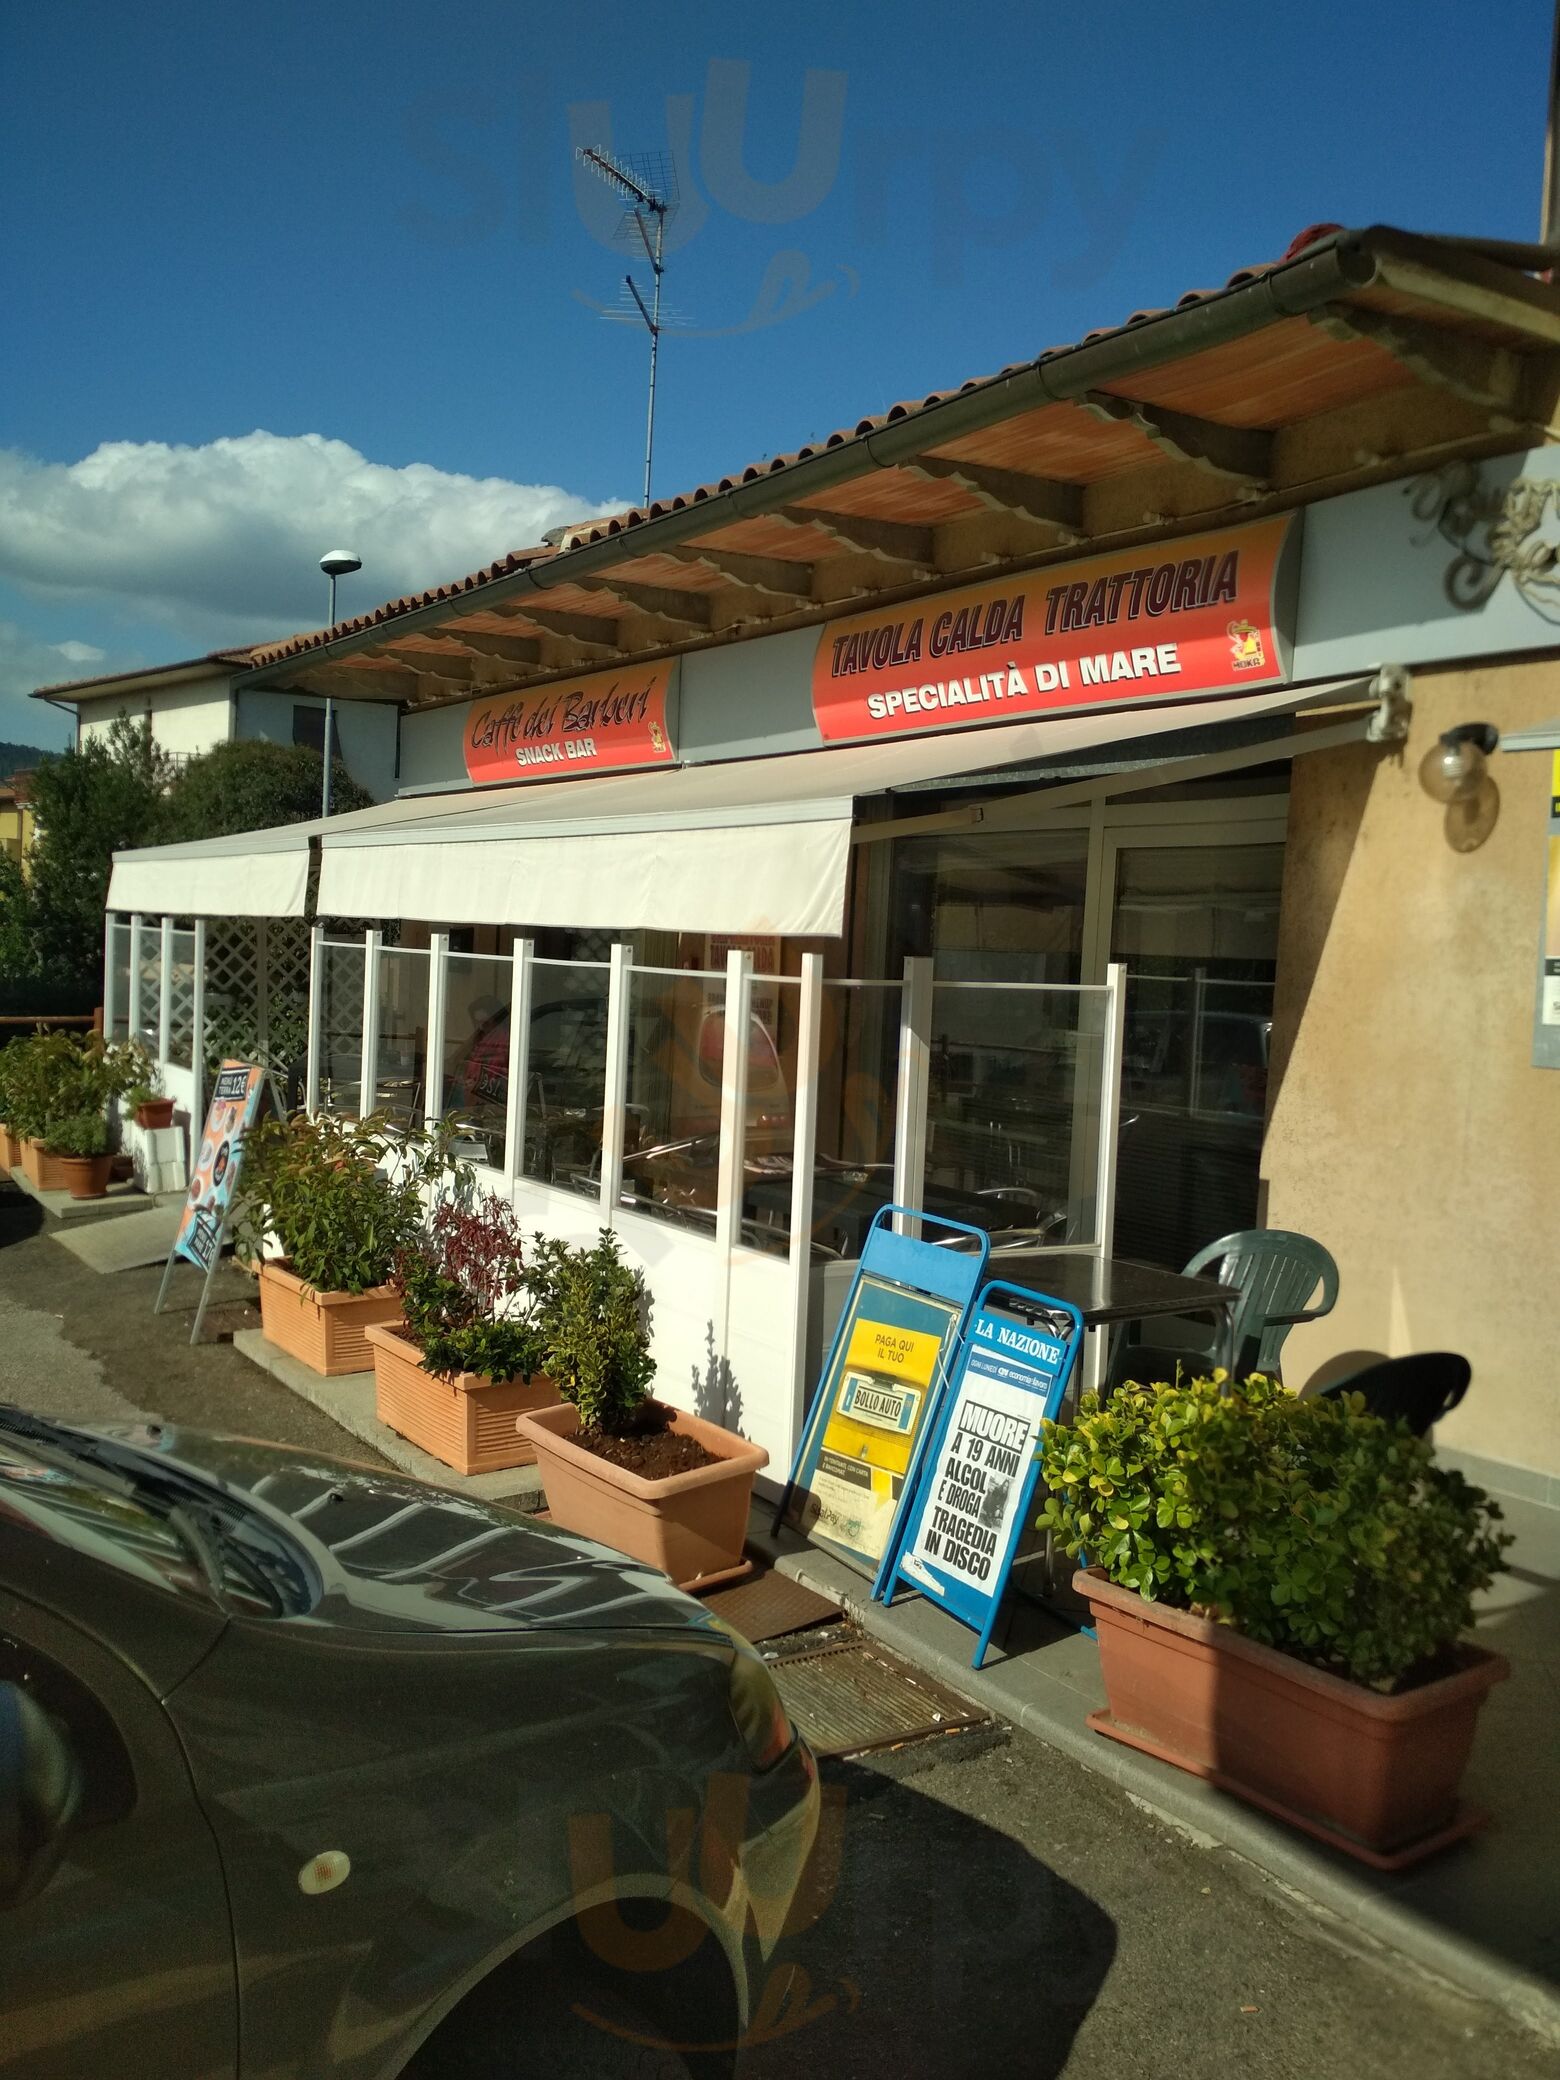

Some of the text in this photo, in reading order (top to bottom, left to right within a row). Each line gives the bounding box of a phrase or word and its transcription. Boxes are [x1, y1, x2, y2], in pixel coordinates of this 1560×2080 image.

[831, 549, 1241, 677] TAVOLA CALDA TRATTORIA
[867, 643, 1181, 720] SPECIALITÀ DI MARE
[515, 738, 598, 767] SNACK BAR
[874, 1334, 915, 1352] PAGA QUI
[877, 1347, 905, 1363] IL TUO
[975, 1319, 1060, 1365] LA NAZIONE
[854, 1389, 902, 1417] BOLLO AUTO
[959, 1402, 1028, 1451] MUORE
[945, 1457, 987, 1494] ALCOL
[950, 1432, 1021, 1478] A 19 ANNI
[938, 1480, 982, 1518] E DROGA
[931, 1506, 998, 1557] TRAGEDIA
[924, 1529, 991, 1581] IN DISCO
